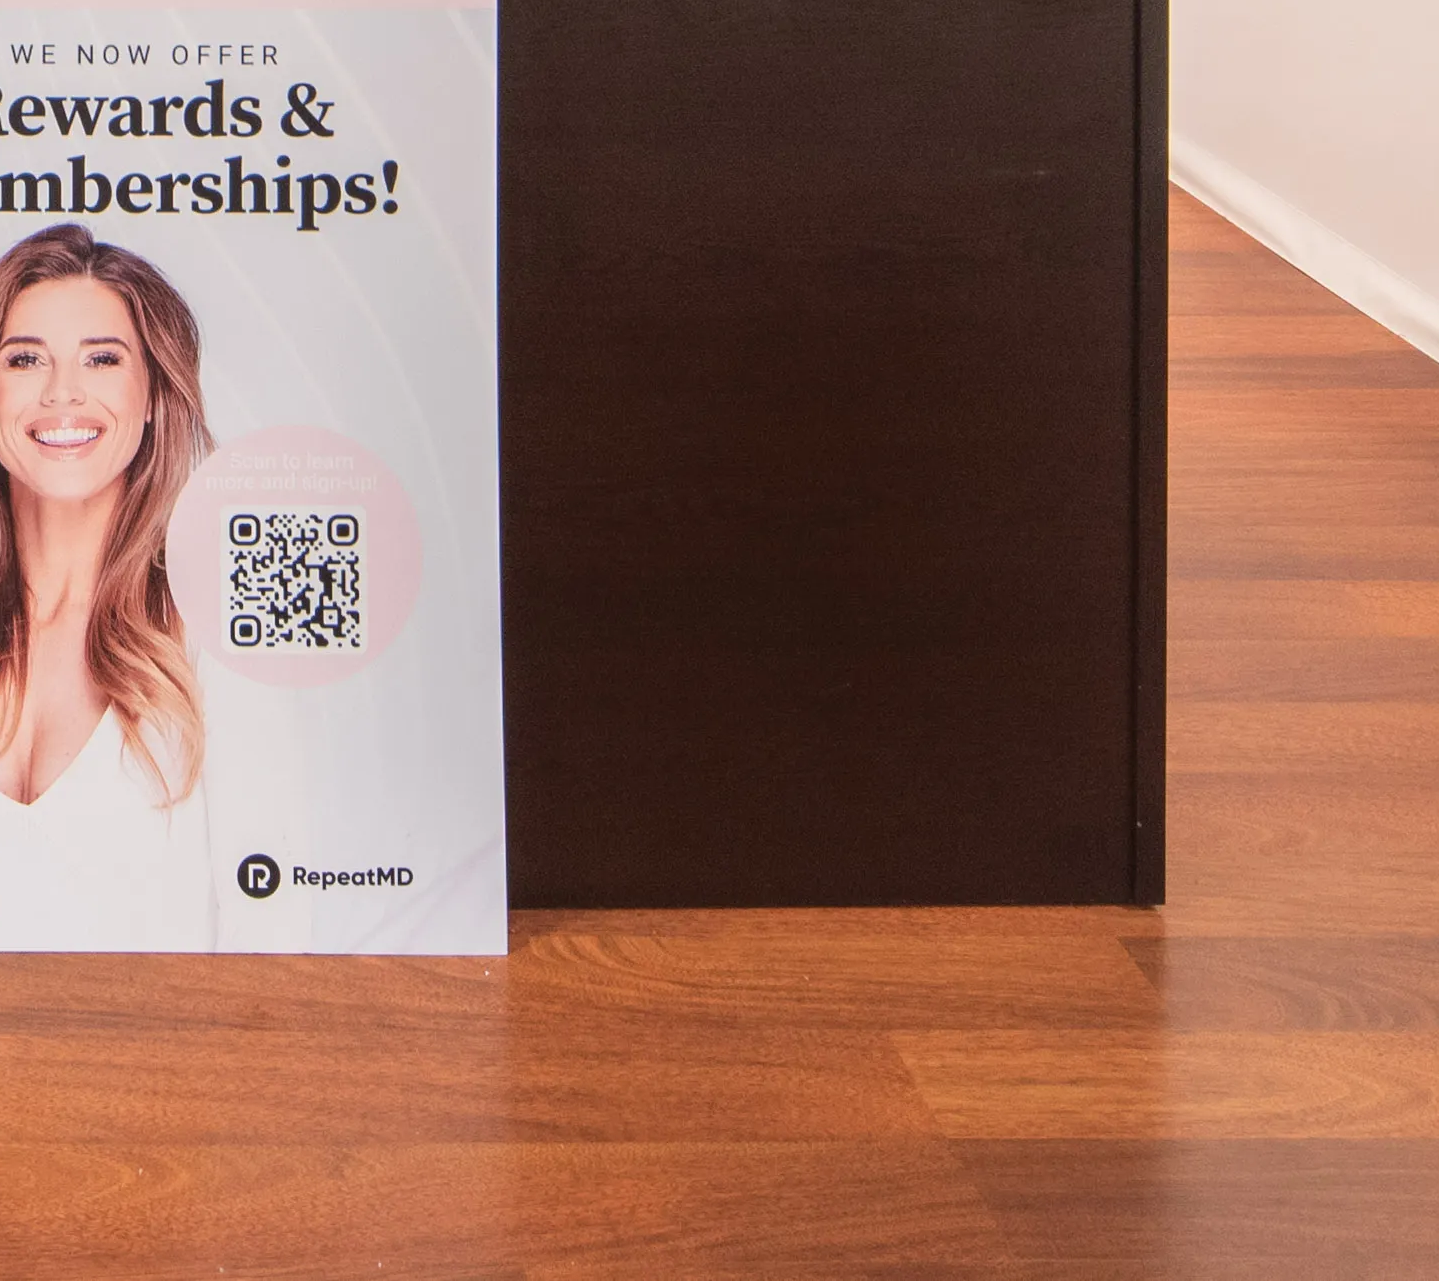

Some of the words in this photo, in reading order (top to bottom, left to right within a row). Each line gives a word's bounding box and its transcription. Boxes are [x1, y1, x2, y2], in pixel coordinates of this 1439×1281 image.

[10, 44, 57, 65] WE
[77, 44, 151, 65] NOW
[172, 44, 279, 66] OFFER
[279, 82, 335, 138] &
[229, 452, 276, 470] Scan
[282, 453, 301, 470] to
[306, 451, 355, 470] learn
[205, 475, 254, 490] more
[260, 472, 296, 491] and
[292, 866, 414, 891] RepeatMD
